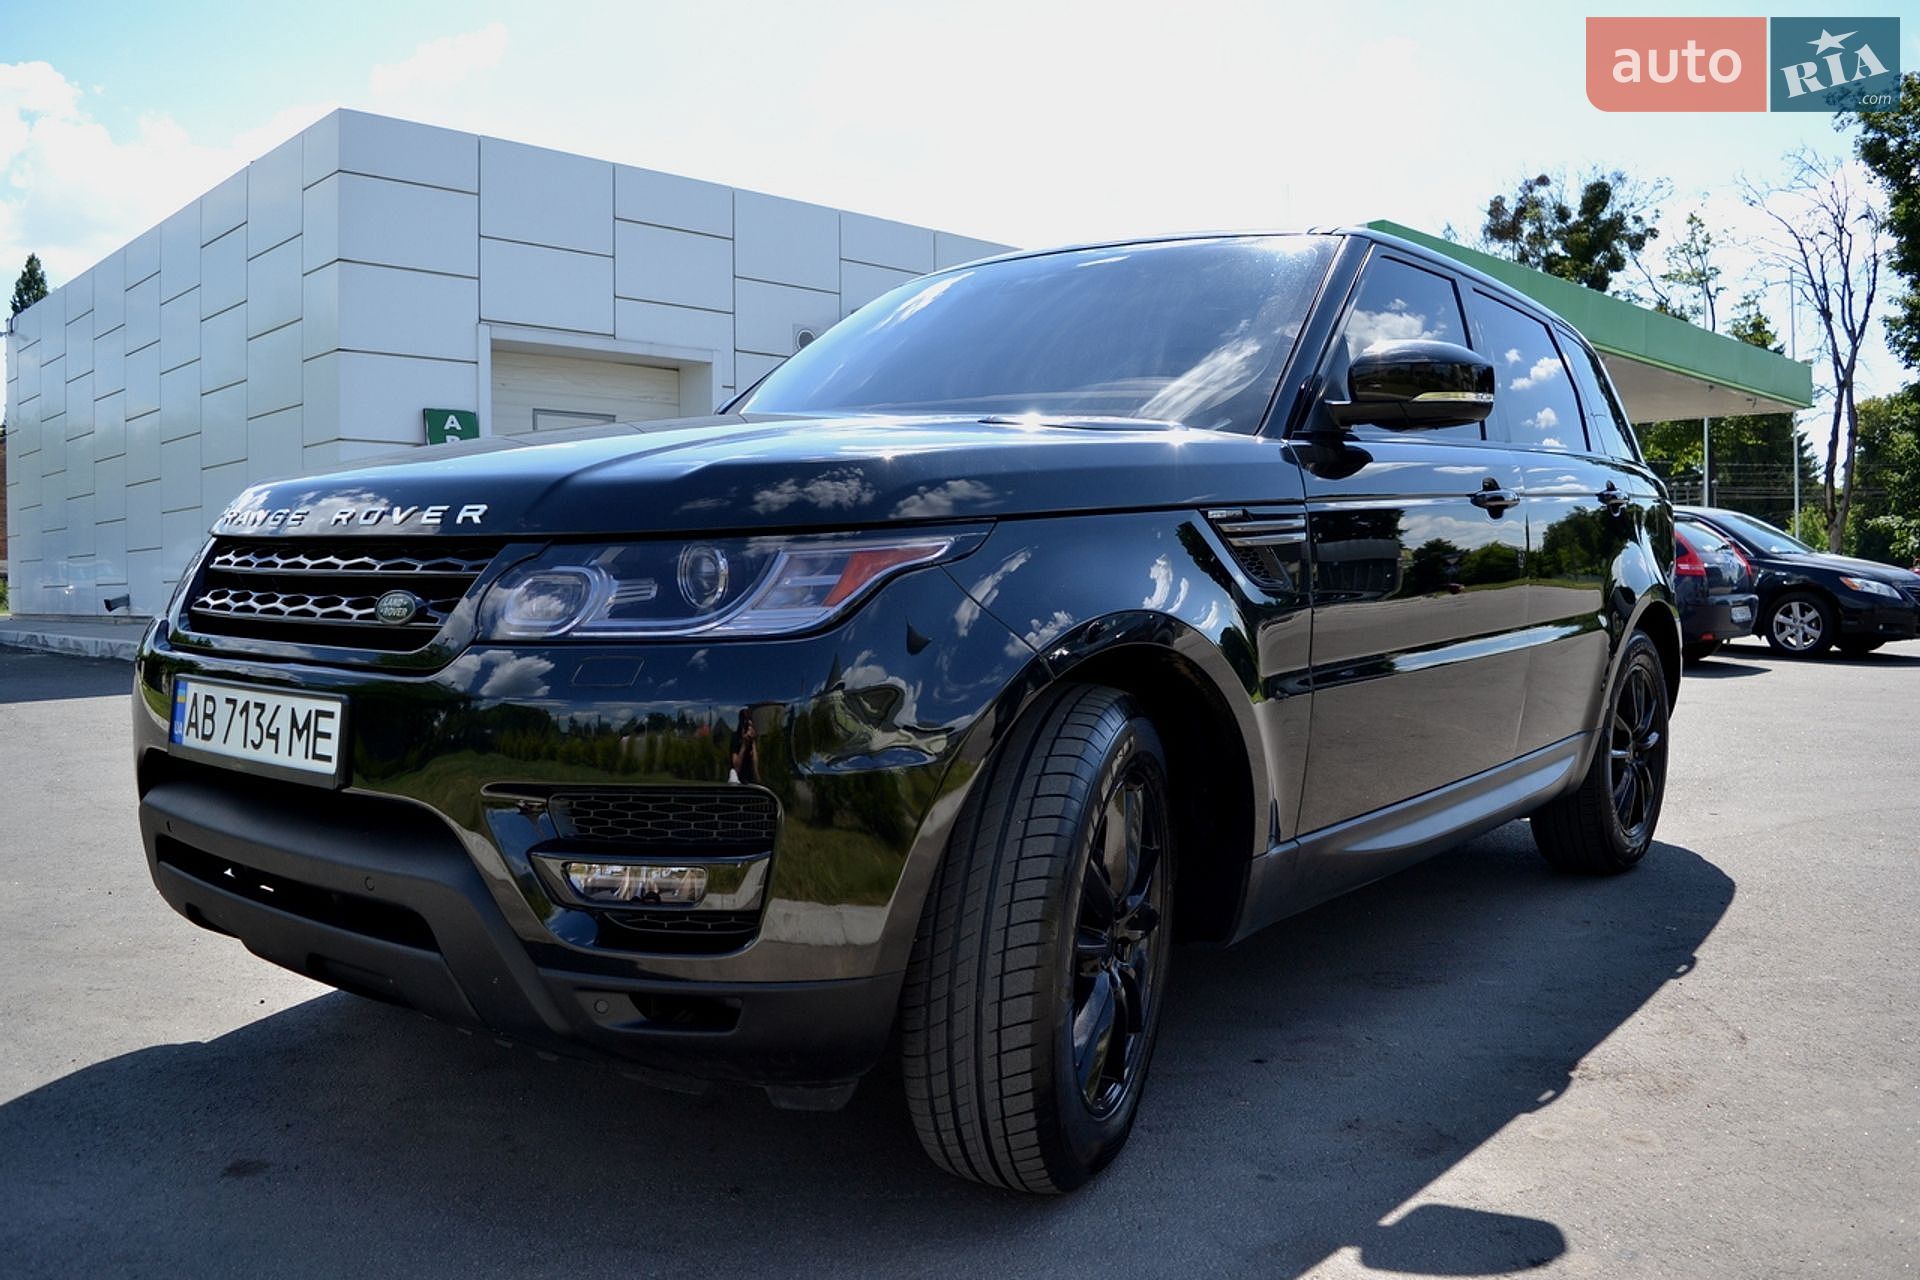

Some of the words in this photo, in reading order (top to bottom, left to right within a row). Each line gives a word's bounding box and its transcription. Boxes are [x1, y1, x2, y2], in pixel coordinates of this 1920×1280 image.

[222, 508, 310, 528] RANGE
[330, 503, 489, 526] ROVER
[186, 692, 217, 742] AB
[223, 697, 282, 754] 7134
[288, 706, 336, 763] ME
